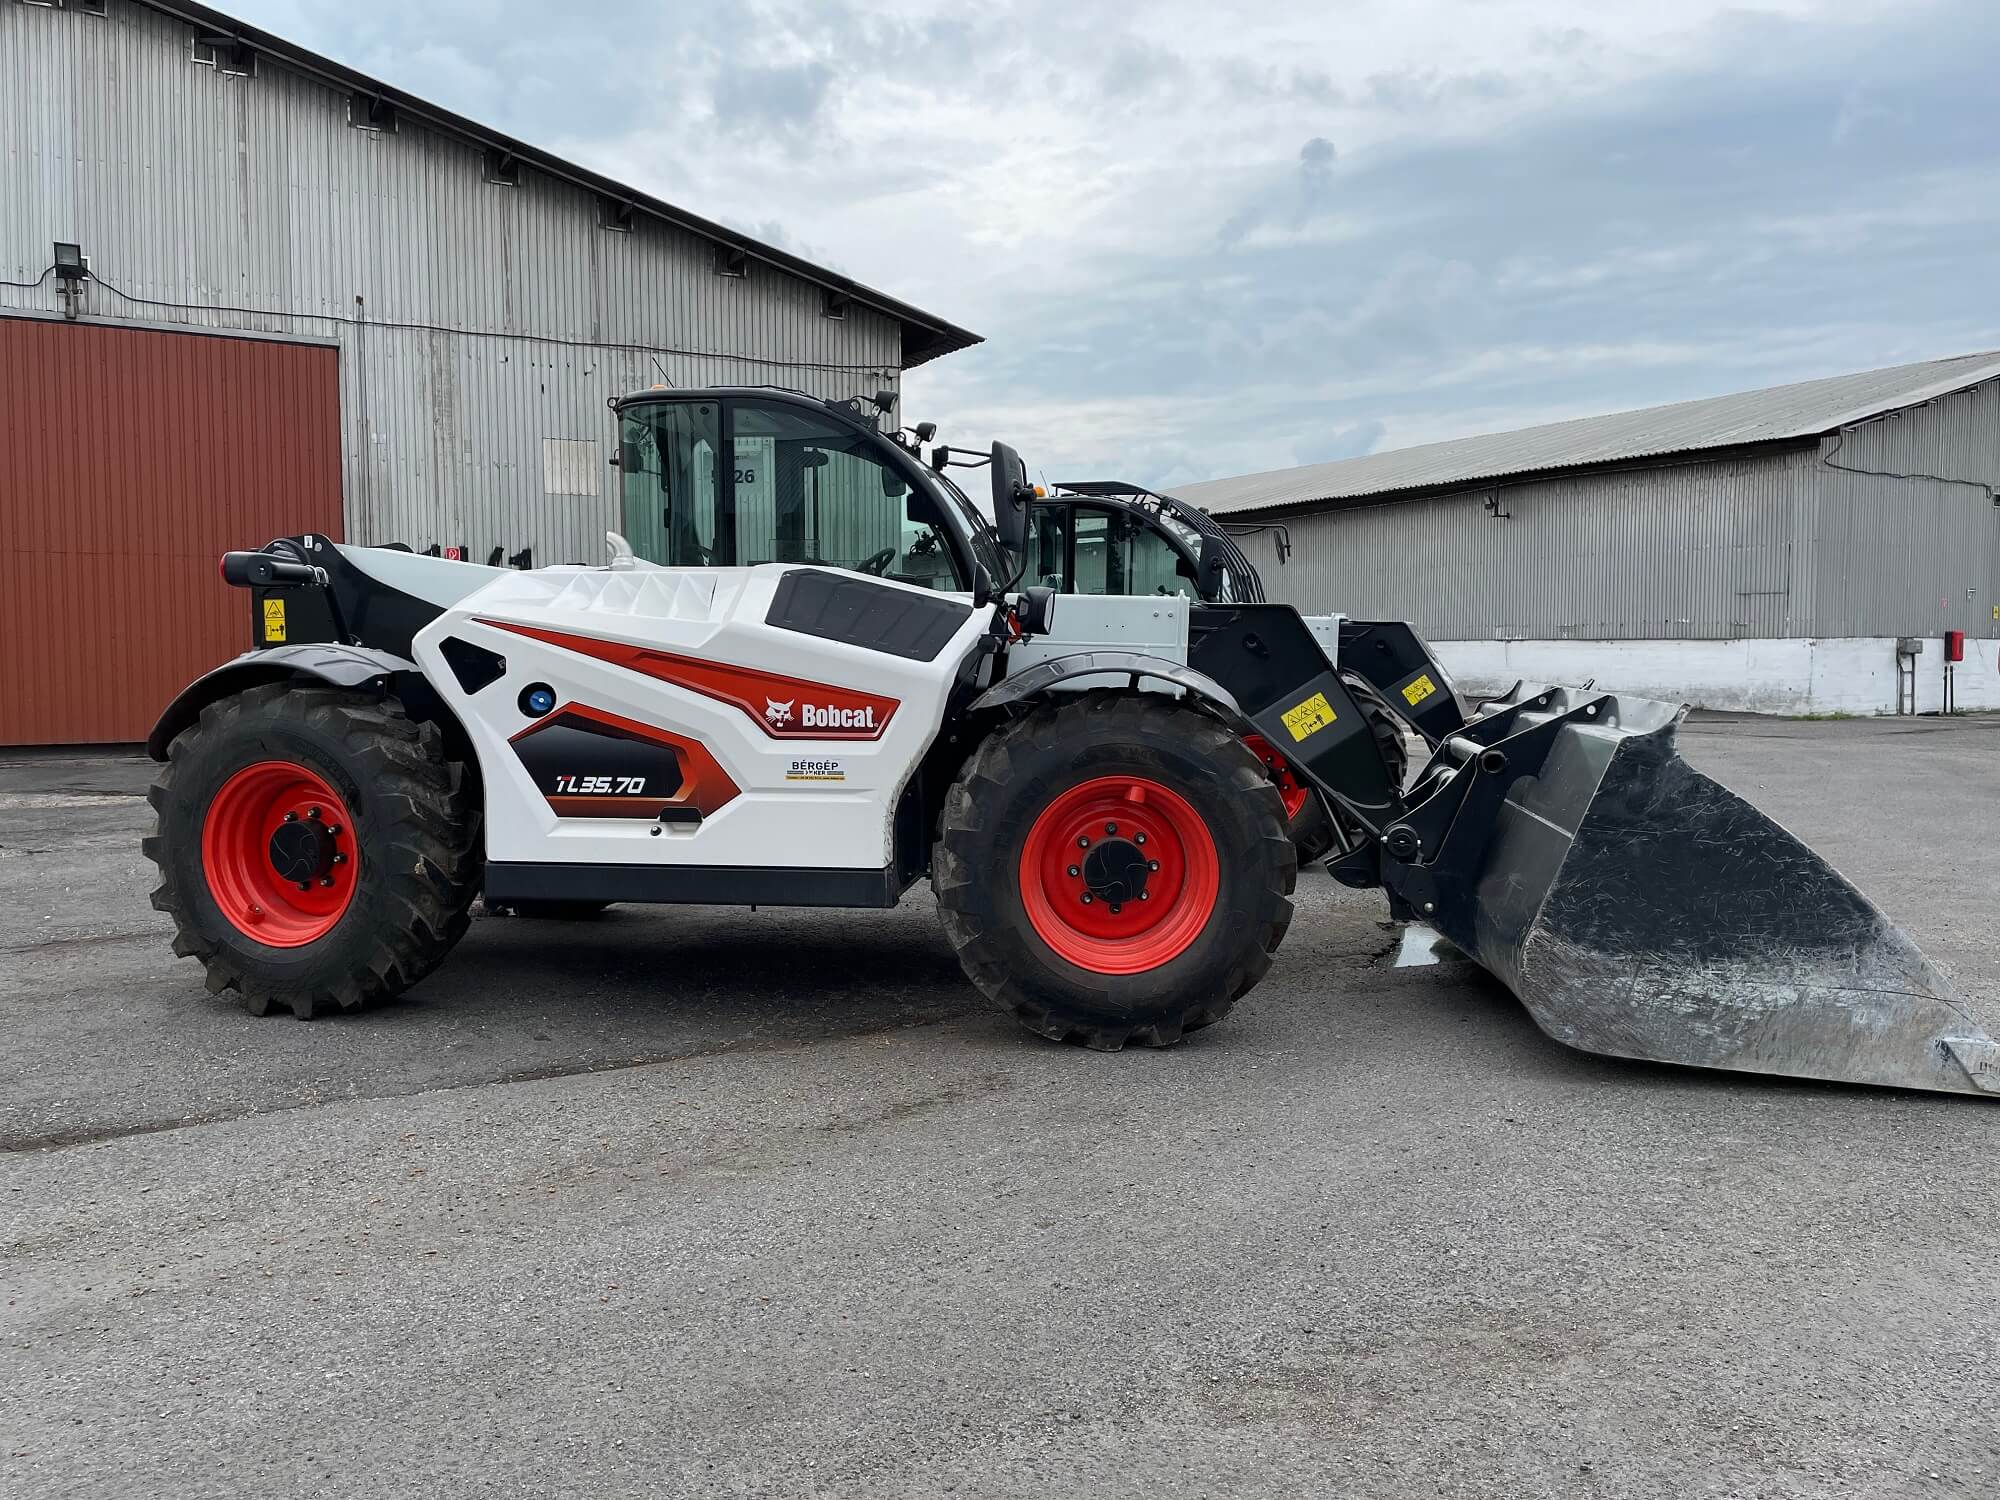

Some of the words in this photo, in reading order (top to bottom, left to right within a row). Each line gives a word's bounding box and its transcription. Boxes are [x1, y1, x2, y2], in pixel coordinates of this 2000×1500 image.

[802, 704, 874, 728] Bobcat
[792, 759, 839, 771] BÉRGÉP
[556, 775, 646, 794] TL35.70
